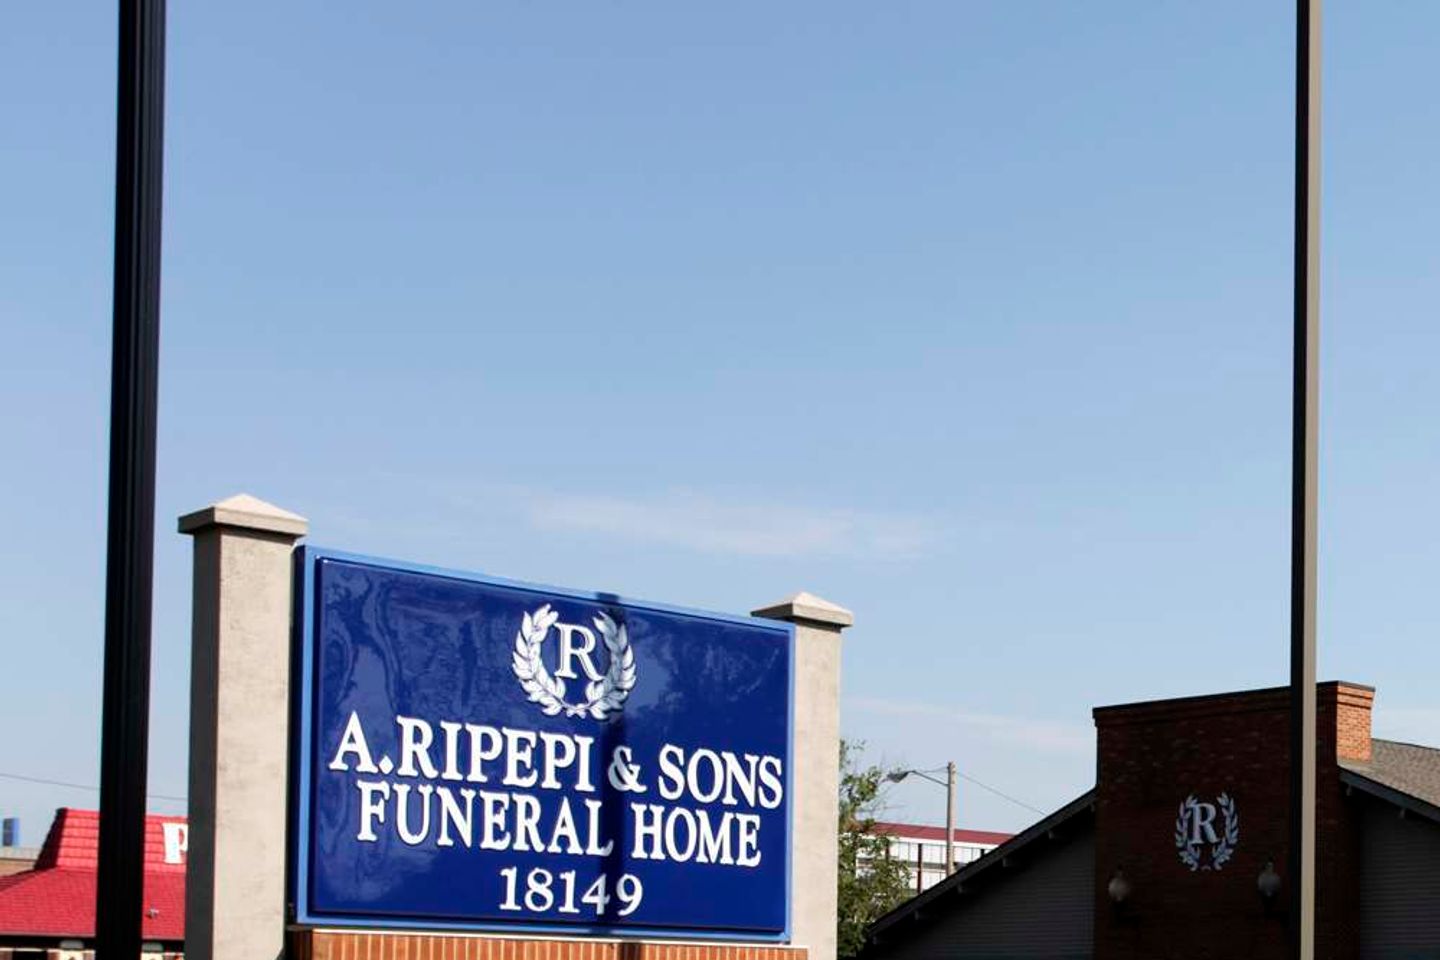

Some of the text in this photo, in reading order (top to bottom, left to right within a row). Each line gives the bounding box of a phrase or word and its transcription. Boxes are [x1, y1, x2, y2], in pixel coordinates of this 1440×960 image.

[552, 622, 606, 681] R
[608, 745, 646, 794] &
[658, 743, 783, 810] SONS
[356, 780, 761, 867] FUNERAL HOME
[1186, 802, 1221, 844] R
[499, 866, 643, 916] 18149
